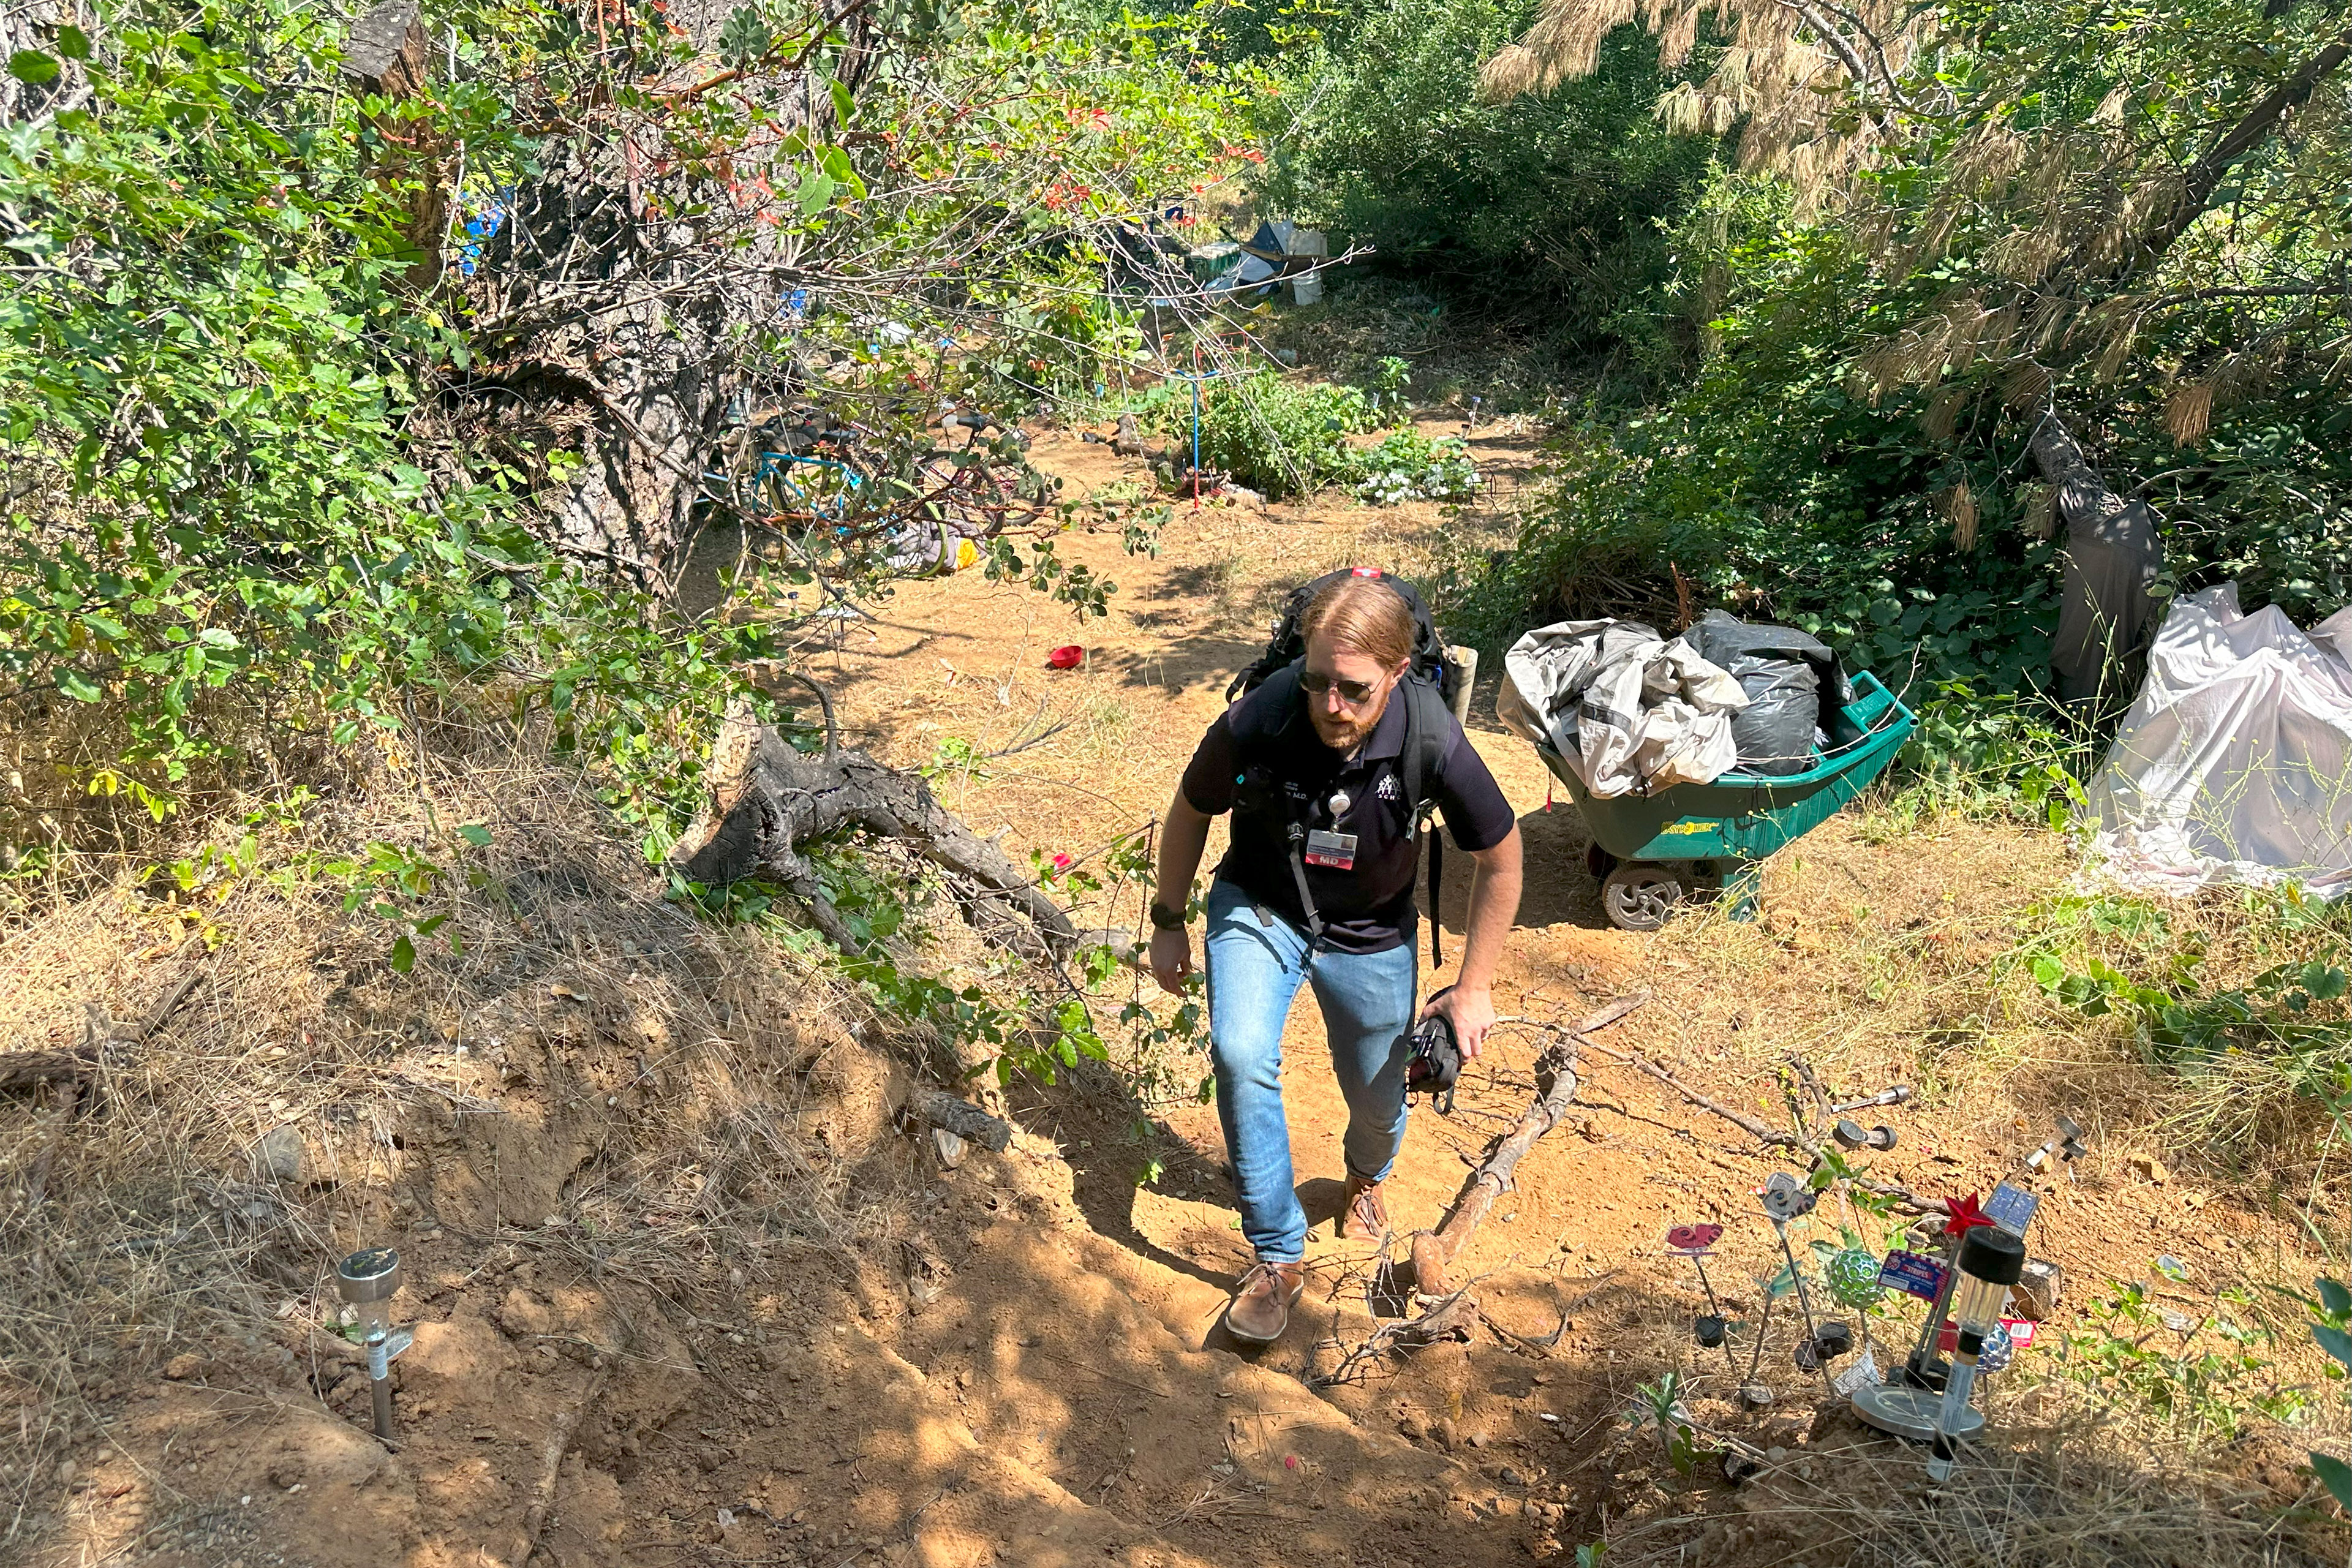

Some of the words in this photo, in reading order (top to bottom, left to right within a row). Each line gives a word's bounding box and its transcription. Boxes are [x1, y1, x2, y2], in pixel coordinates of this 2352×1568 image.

[1293, 792, 1308, 801] M.D.
[1319, 856, 1339, 865] MD
[1905, 1265, 1929, 1279] STRIPES
